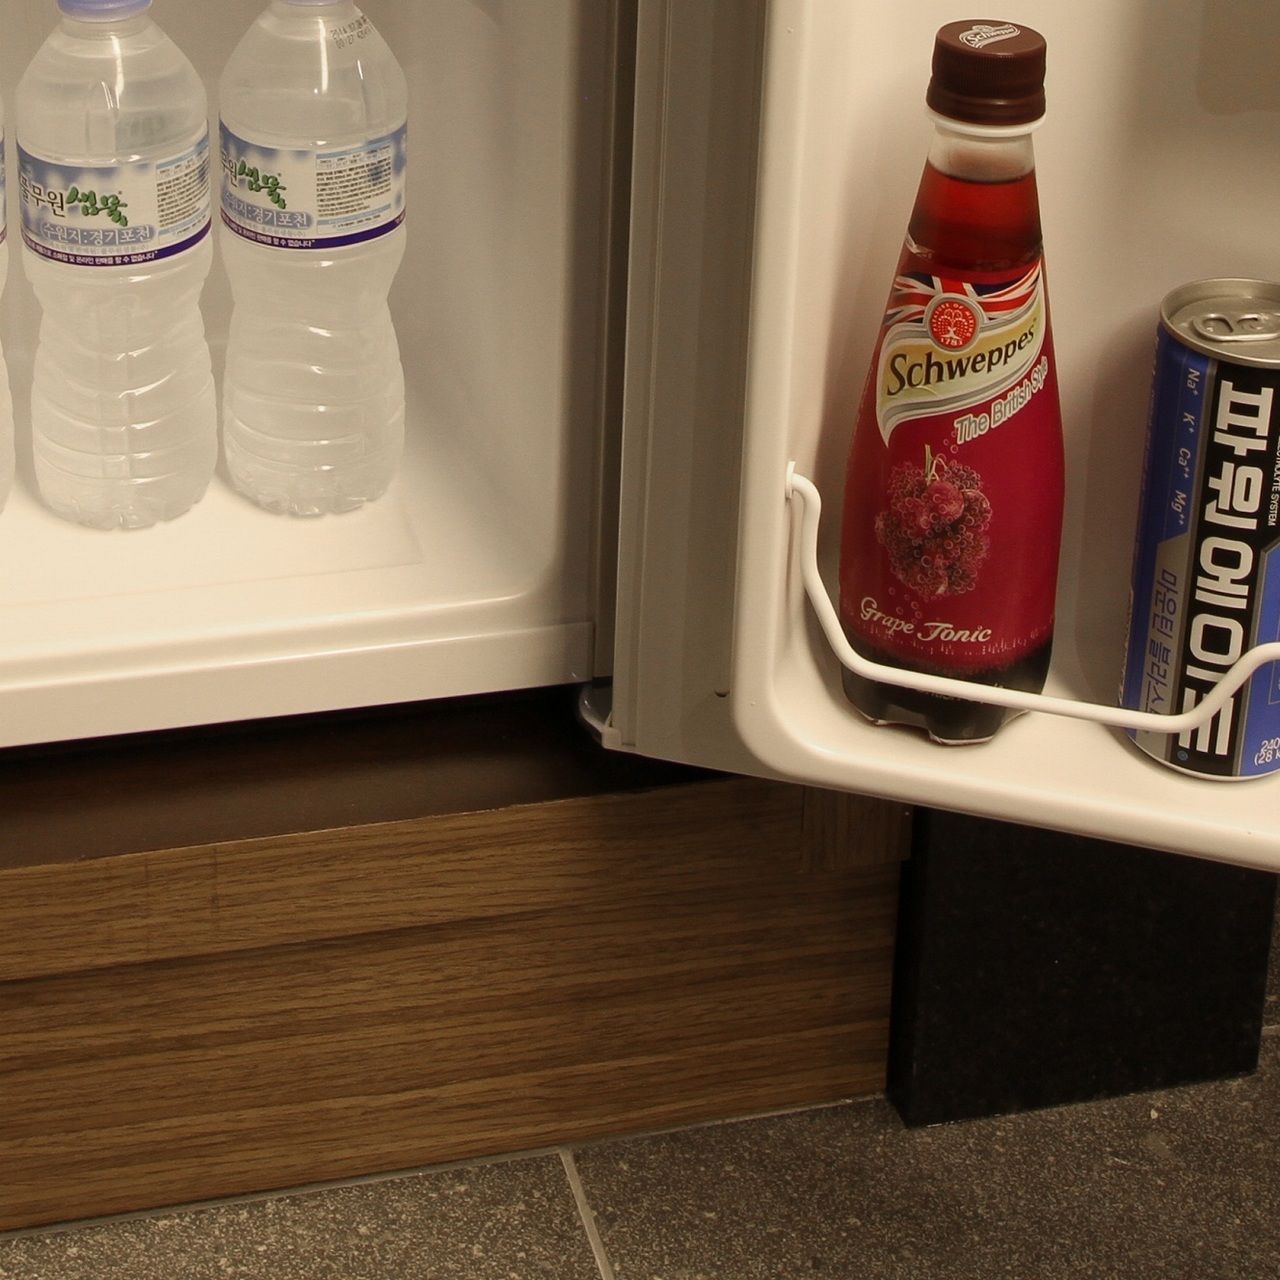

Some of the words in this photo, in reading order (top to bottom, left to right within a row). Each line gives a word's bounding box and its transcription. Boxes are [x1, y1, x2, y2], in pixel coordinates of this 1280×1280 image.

[886, 324, 1036, 397] Schweppes
[953, 411, 989, 445] The
[990, 379, 1033, 429] British
[1031, 355, 1049, 394] Style
[1153, 568, 1178, 639] 마운틴
[1179, 379, 1275, 756] 파워에이드
[860, 596, 915, 636] Grape
[916, 621, 993, 644] Tonic
[1145, 639, 1172, 722] 블라스
[1254, 749, 1273, 767] (28
[1260, 735, 1280, 753] 240
